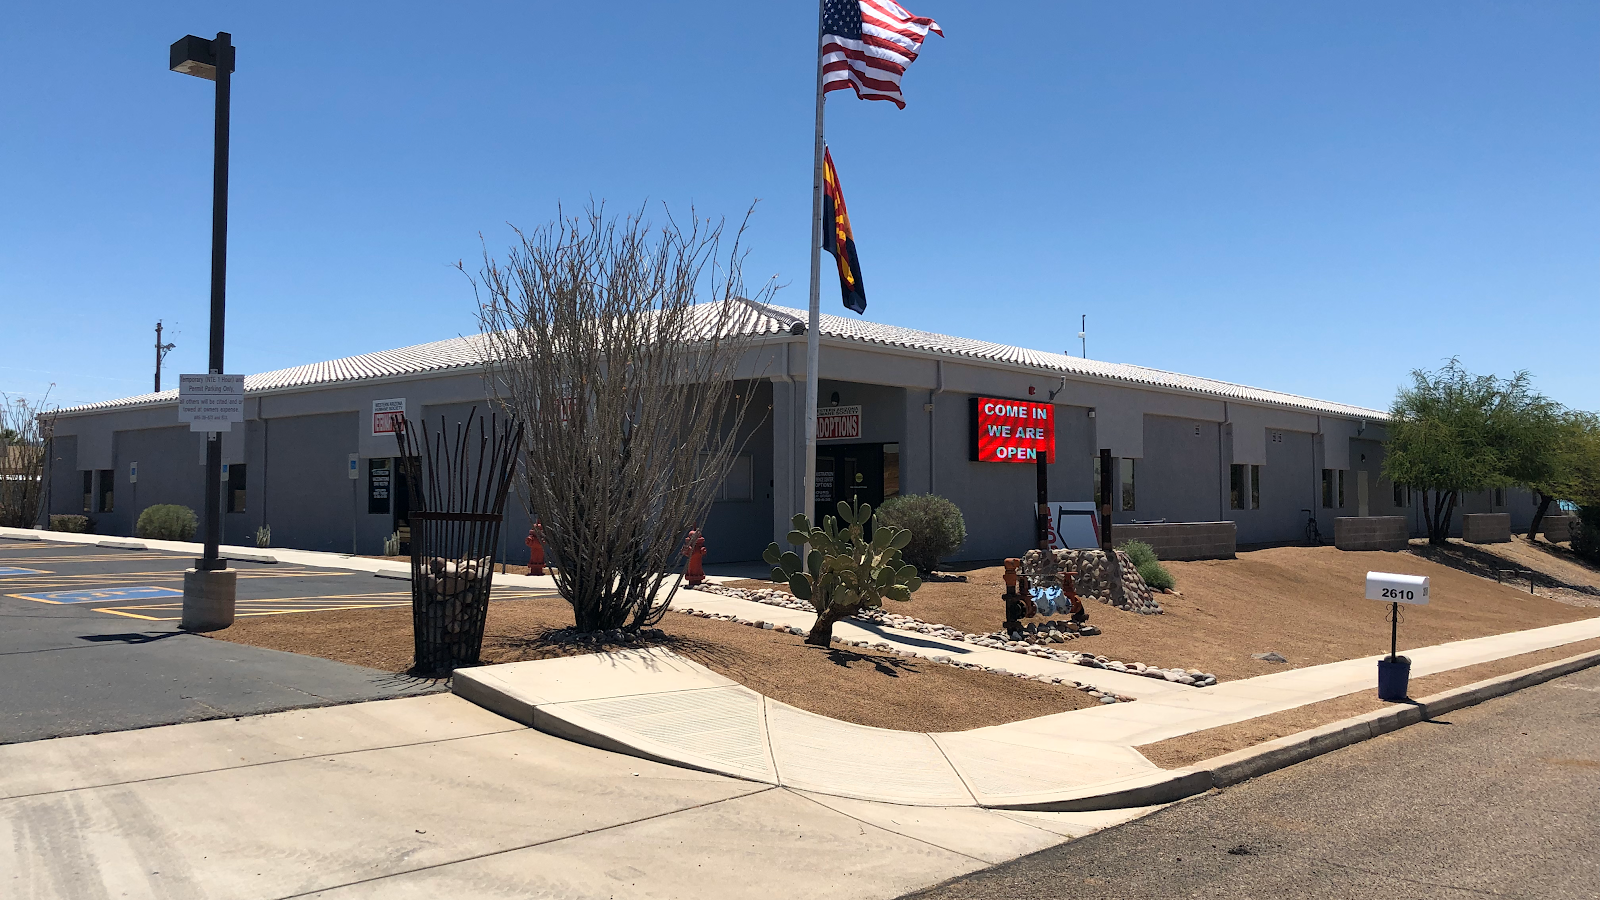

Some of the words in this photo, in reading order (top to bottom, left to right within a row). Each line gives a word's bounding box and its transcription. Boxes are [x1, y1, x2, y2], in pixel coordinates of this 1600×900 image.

[180, 376, 203, 384] Temporary
[205, 385, 222, 393] Parking
[984, 403, 1028, 418] COME
[1032, 408, 1047, 420] IN
[987, 425, 1011, 438] WE
[1015, 427, 1045, 440] ARE
[996, 447, 1037, 459] OPEN
[1381, 588, 1414, 600] 2610
